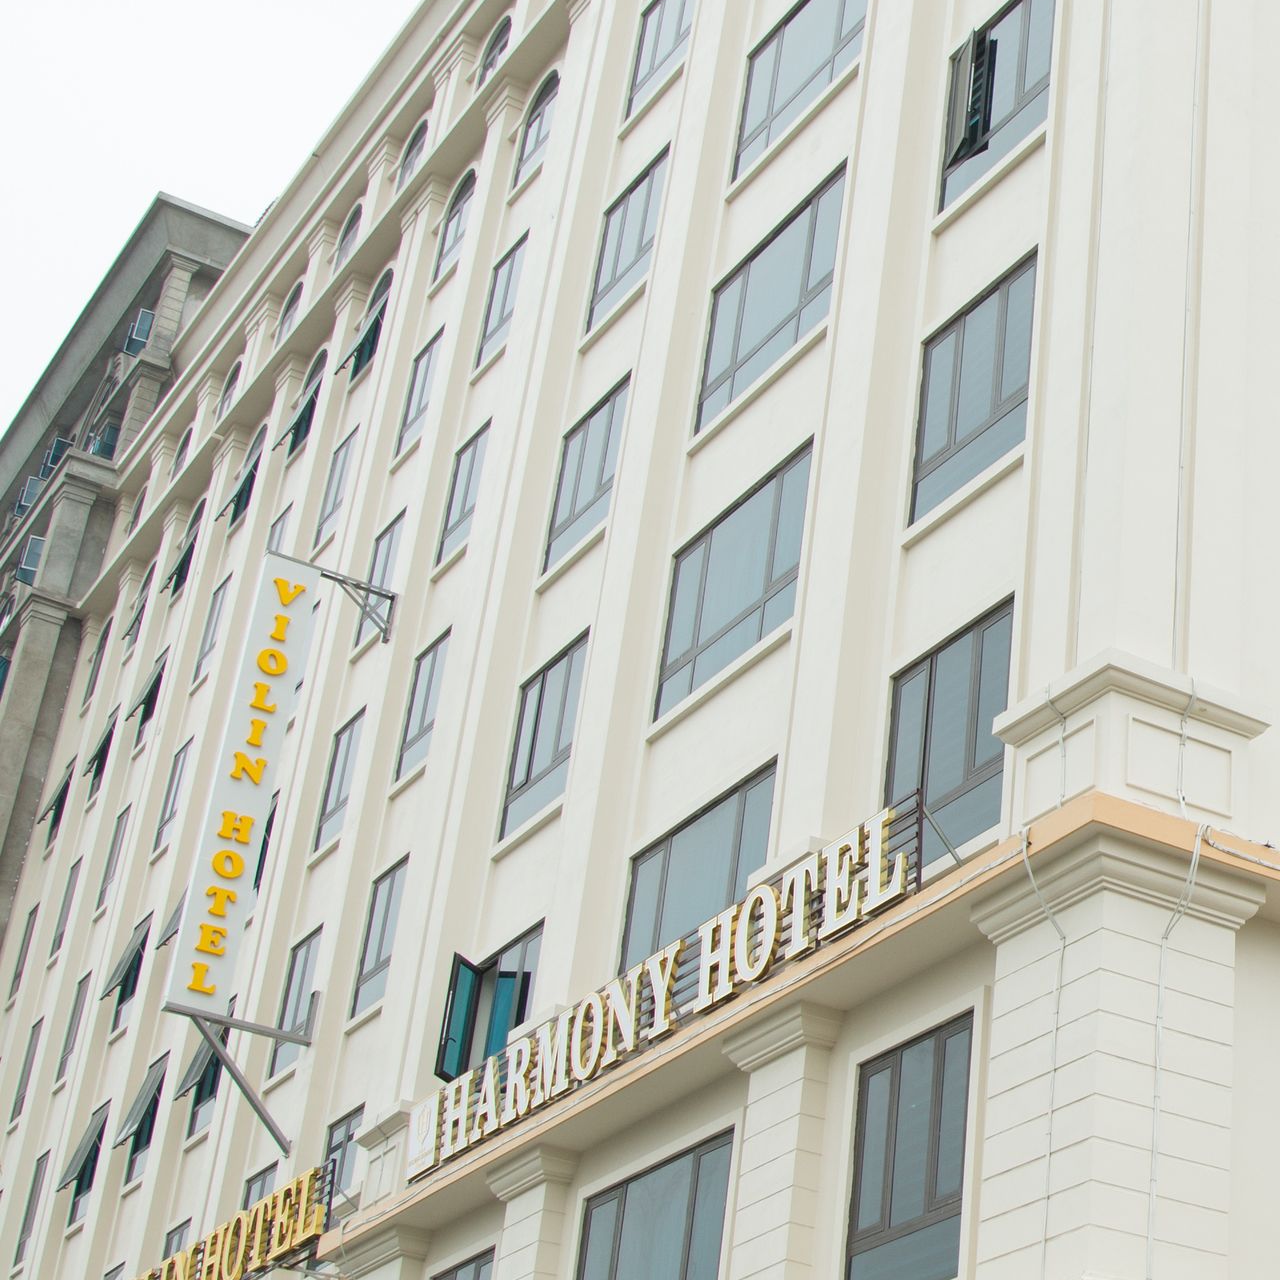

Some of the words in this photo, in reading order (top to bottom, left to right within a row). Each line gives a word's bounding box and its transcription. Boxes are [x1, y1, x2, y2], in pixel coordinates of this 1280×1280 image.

[231, 578, 306, 785] VIOLIN
[188, 811, 254, 995] HOTEL
[441, 940, 686, 1160] HARMONY
[694, 808, 908, 1013] HOTEL
